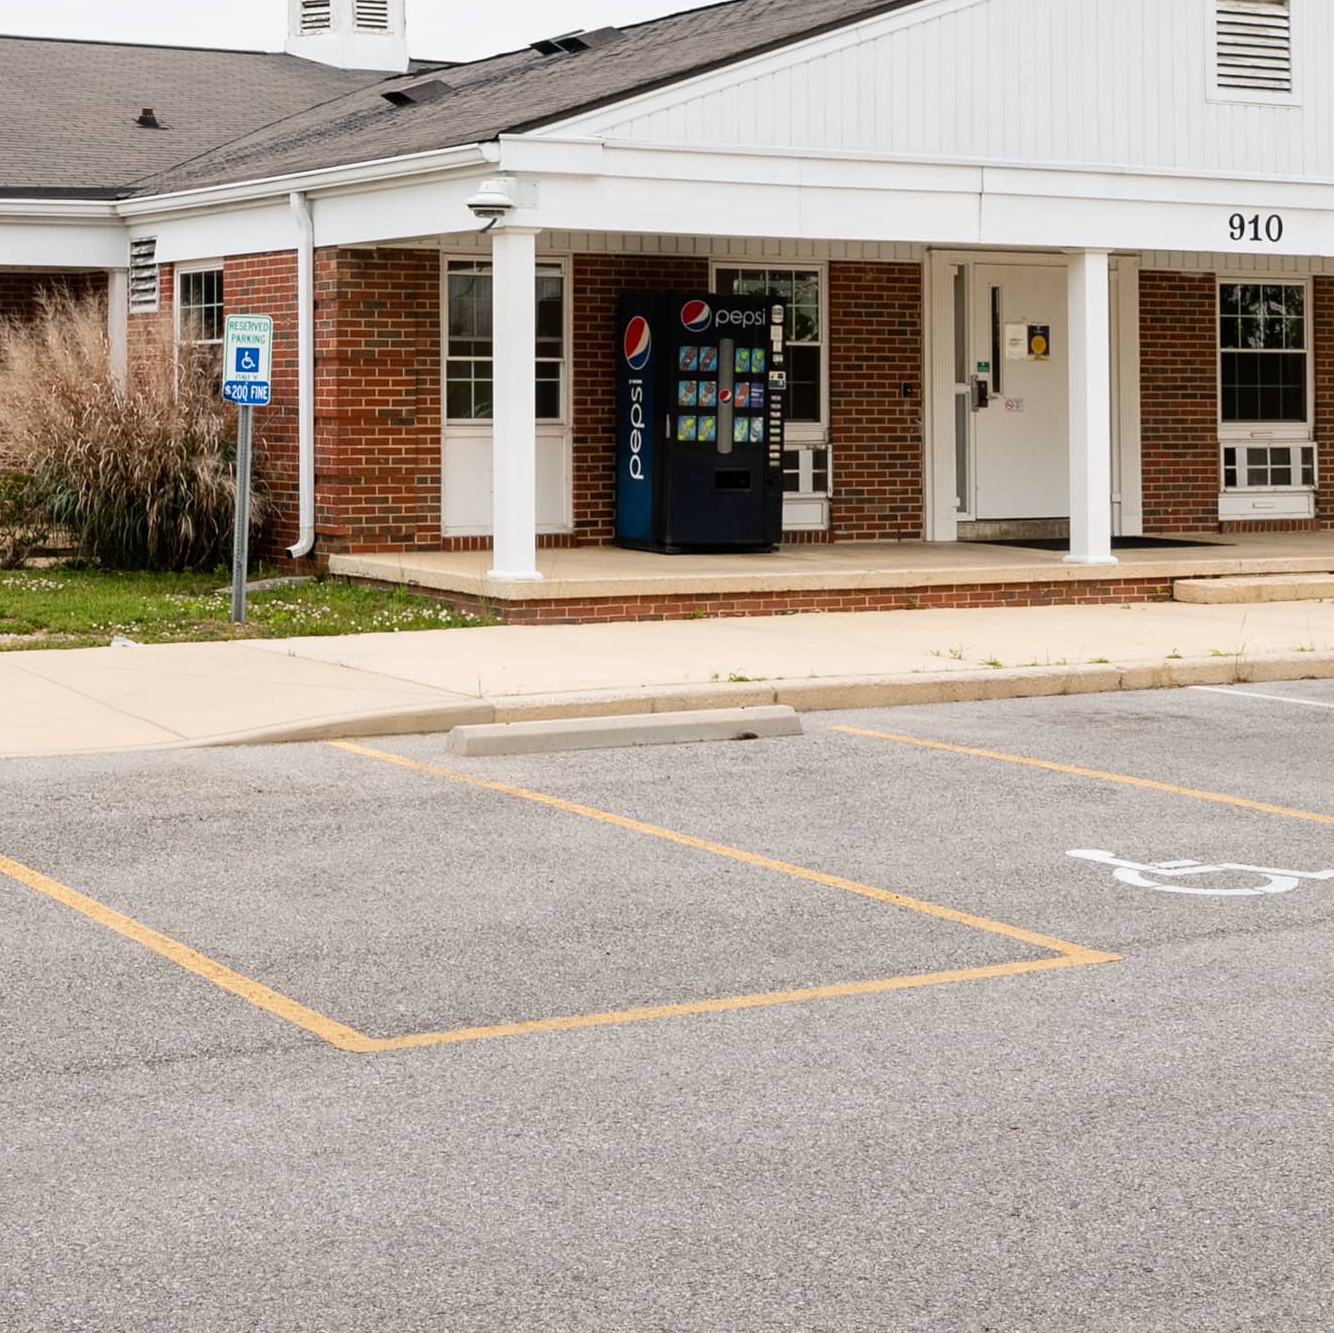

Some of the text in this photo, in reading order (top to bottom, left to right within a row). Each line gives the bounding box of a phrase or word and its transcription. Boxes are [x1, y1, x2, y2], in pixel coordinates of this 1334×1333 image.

[1229, 213, 1283, 242] 910
[229, 321, 268, 332] RESERVED
[715, 308, 766, 329] pepsi
[231, 334, 266, 344] PARKING
[251, 385, 268, 400] FINE
[629, 378, 645, 480] pepsi
